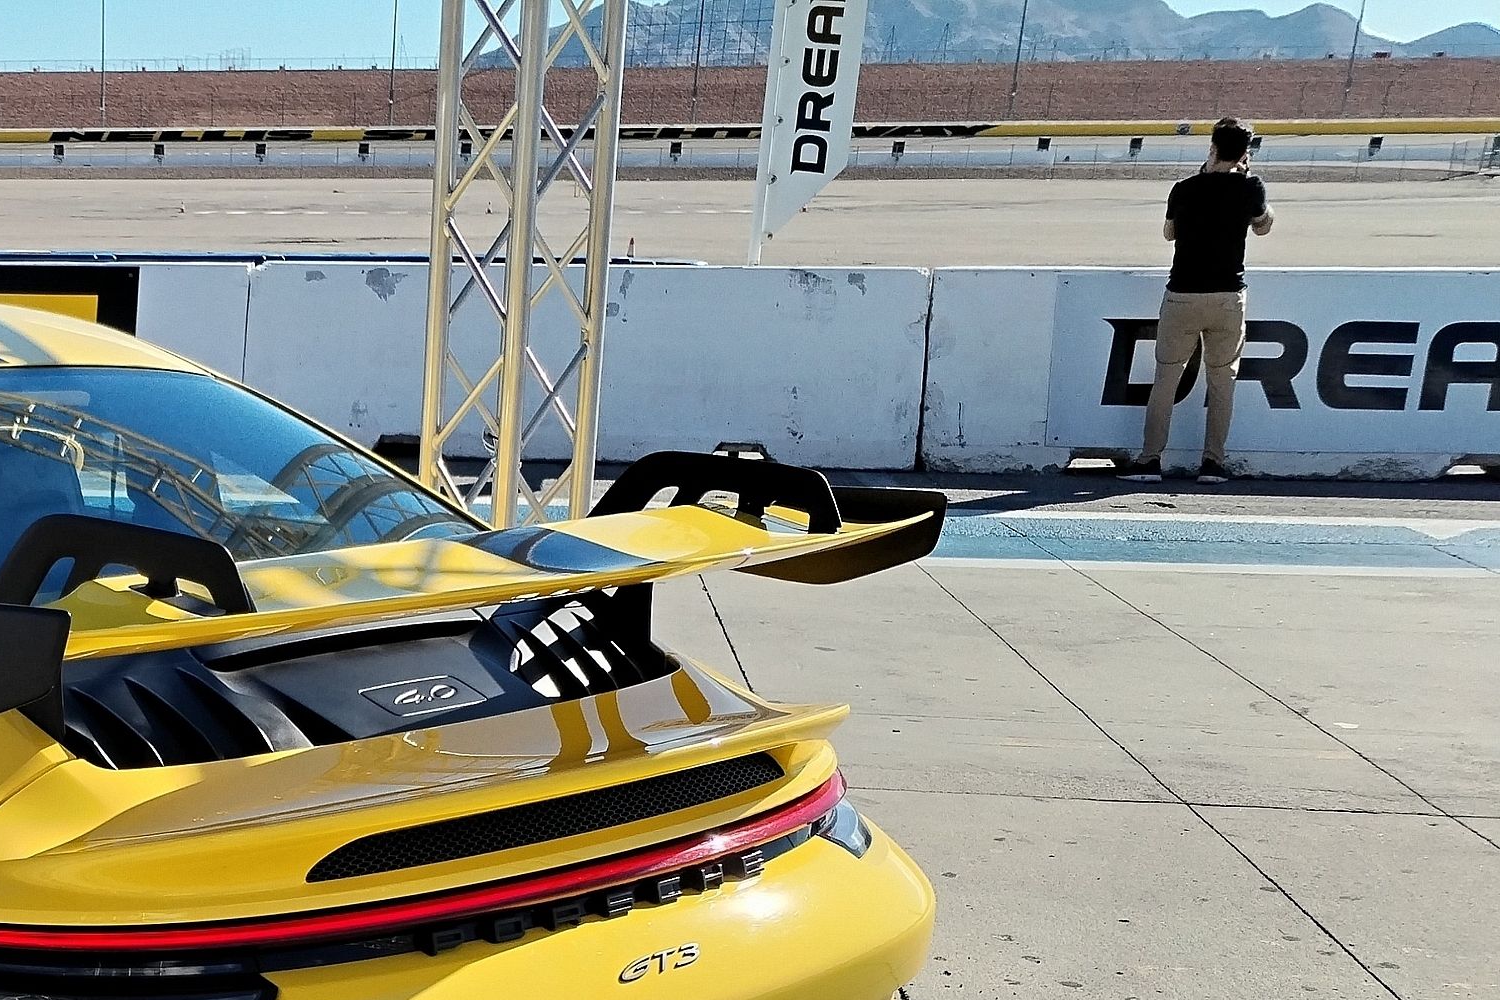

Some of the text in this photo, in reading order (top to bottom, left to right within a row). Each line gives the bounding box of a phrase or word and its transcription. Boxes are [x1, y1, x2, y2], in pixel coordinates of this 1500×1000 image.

[790, 0, 846, 175] DREA
[49, 129, 314, 142] NELLIS
[393, 684, 458, 705] 4.0
[429, 849, 765, 956] PORSCHE
[618, 942, 701, 984] GT3
